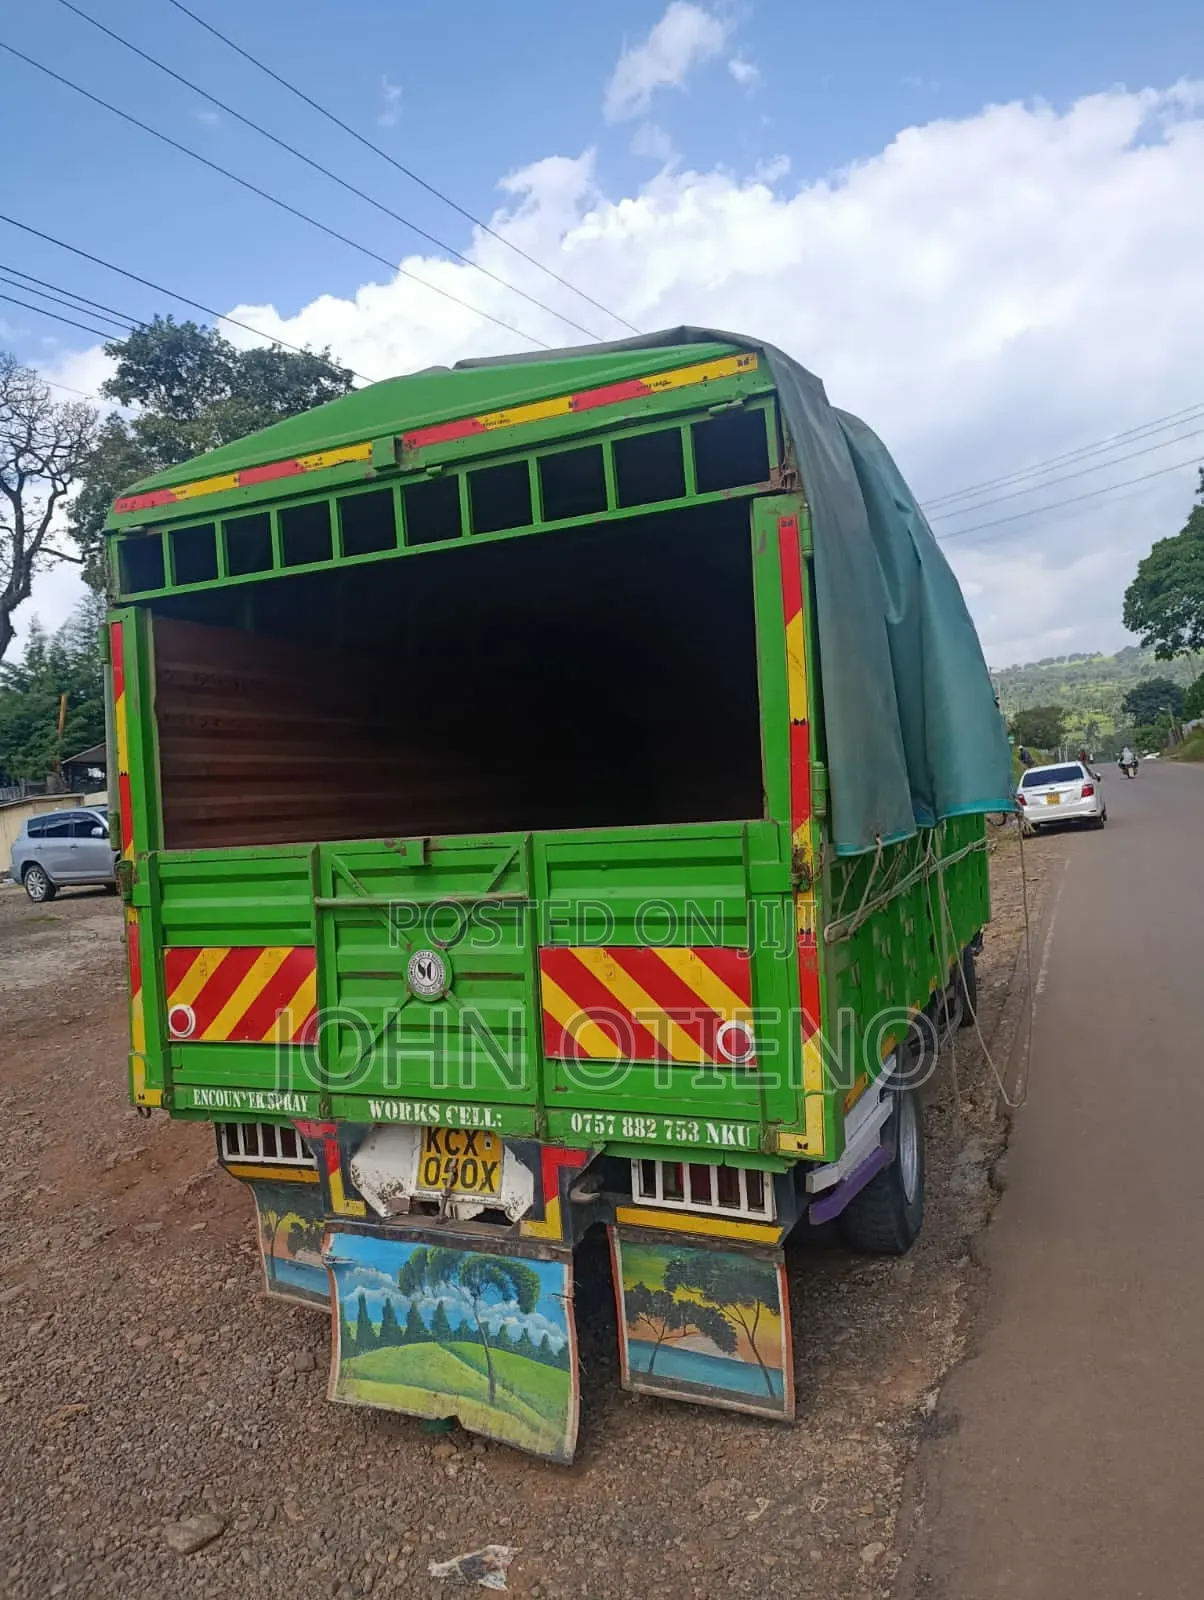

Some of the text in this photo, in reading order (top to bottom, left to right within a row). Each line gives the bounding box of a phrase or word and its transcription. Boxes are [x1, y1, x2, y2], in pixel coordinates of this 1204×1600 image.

[368, 1099, 440, 1123] WORKS
[445, 1105, 503, 1128] CELL:
[570, 1112, 616, 1135] 0757
[622, 1116, 657, 1139] 882
[663, 1119, 700, 1142] 753
[705, 1122, 750, 1146] NKU
[426, 1126, 478, 1157] KCX
